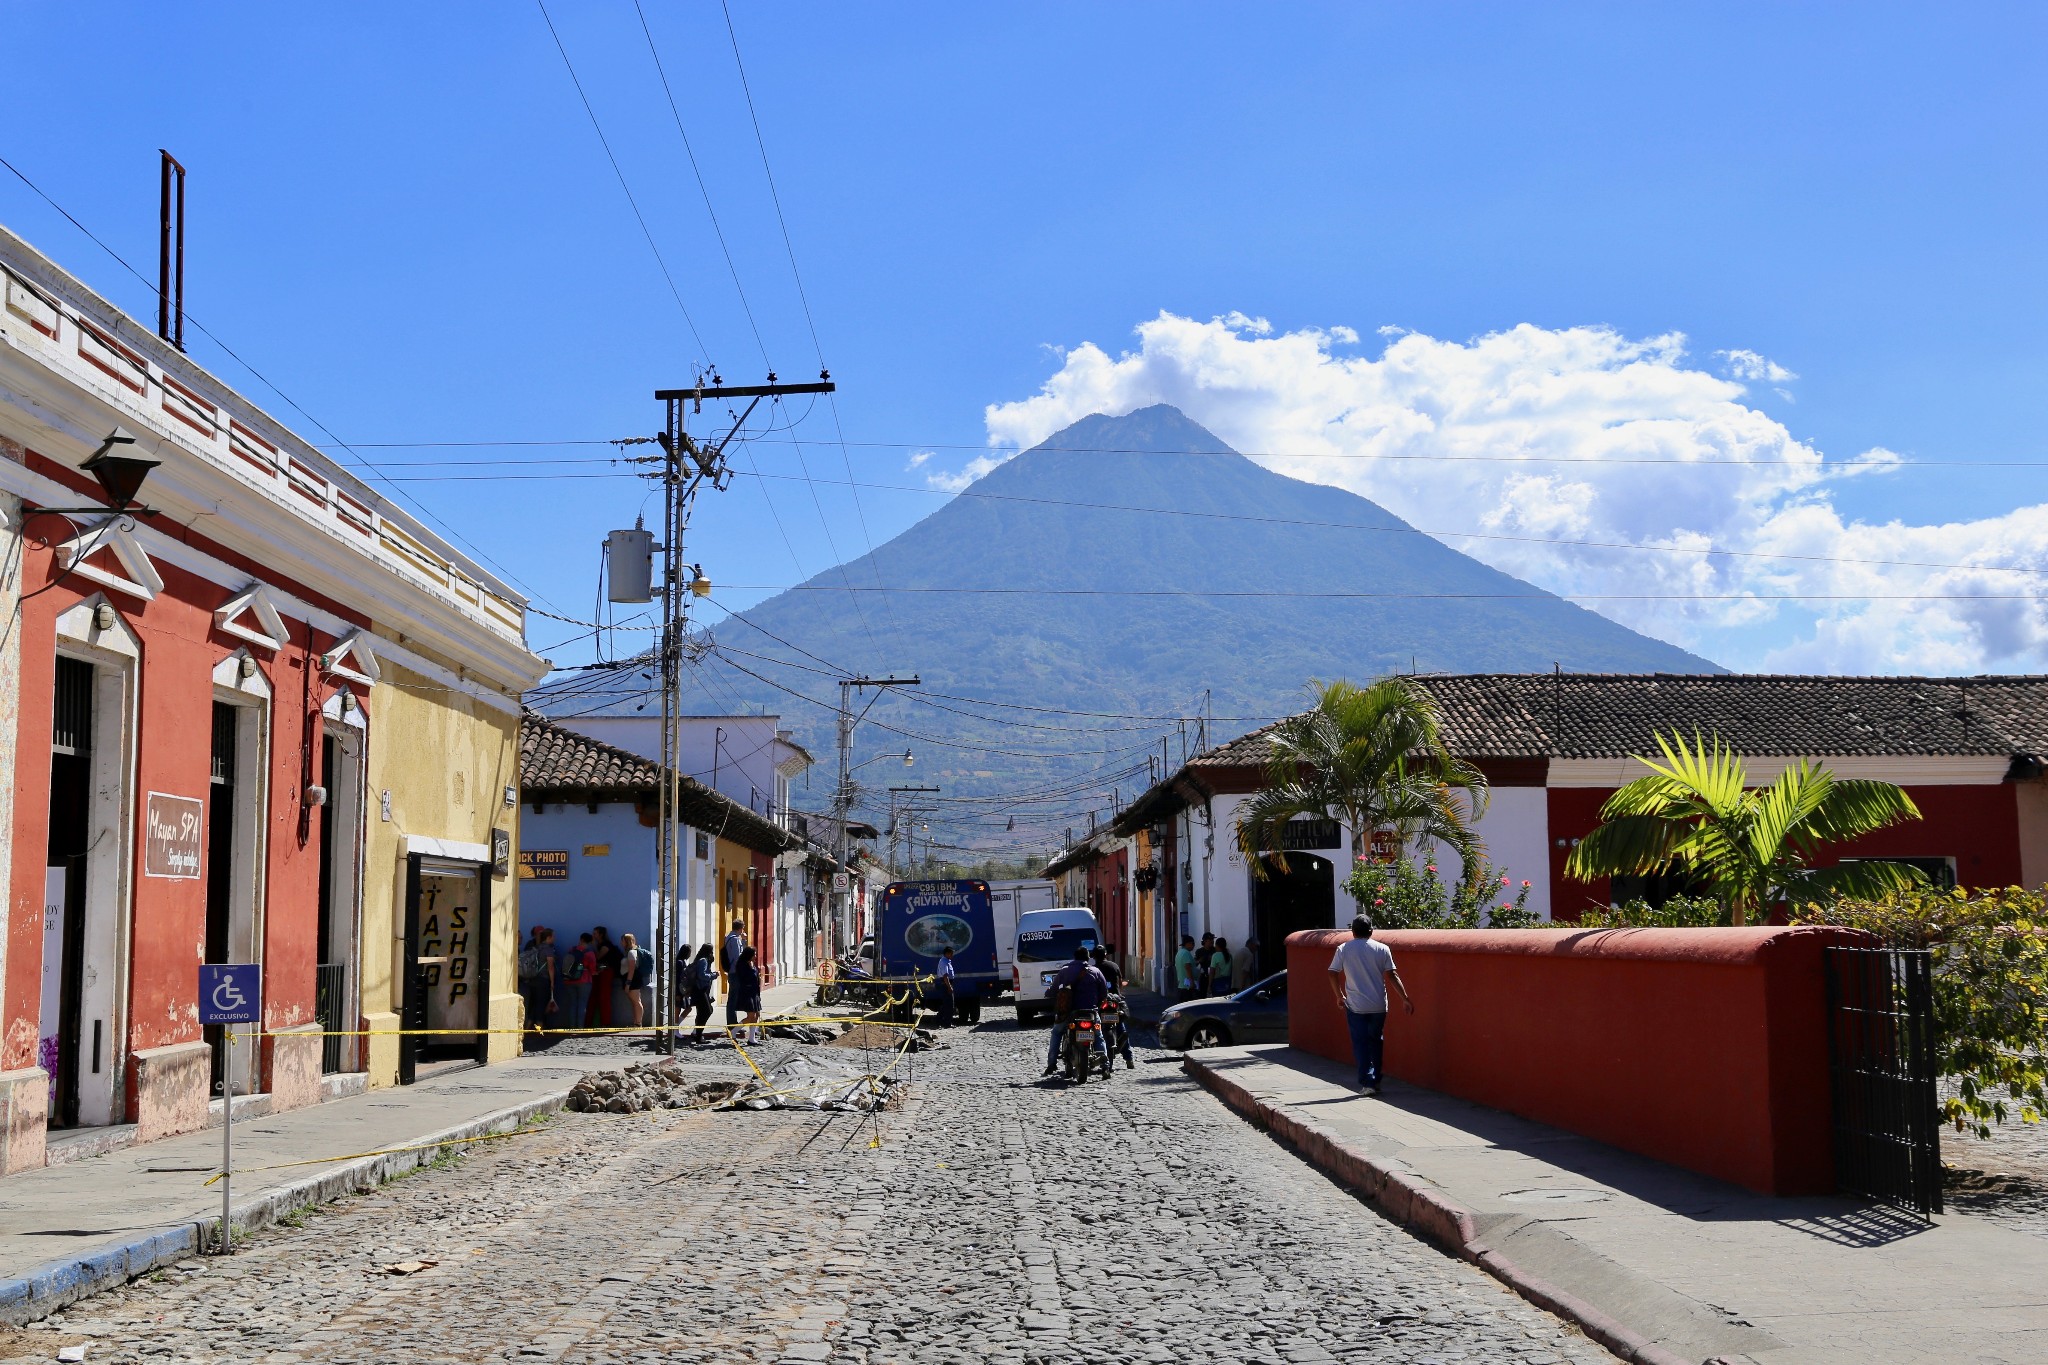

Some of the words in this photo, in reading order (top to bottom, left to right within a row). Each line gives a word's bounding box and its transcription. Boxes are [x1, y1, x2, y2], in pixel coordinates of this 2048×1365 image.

[149, 808, 177, 853] Mayan
[180, 811, 199, 843] SPA
[536, 853, 566, 863] PHOTO
[536, 867, 566, 876] Konica
[905, 894, 971, 914] SALVAVIDAS
[1021, 930, 1053, 942] C339BQZ
[449, 906, 469, 1006] SHOP
